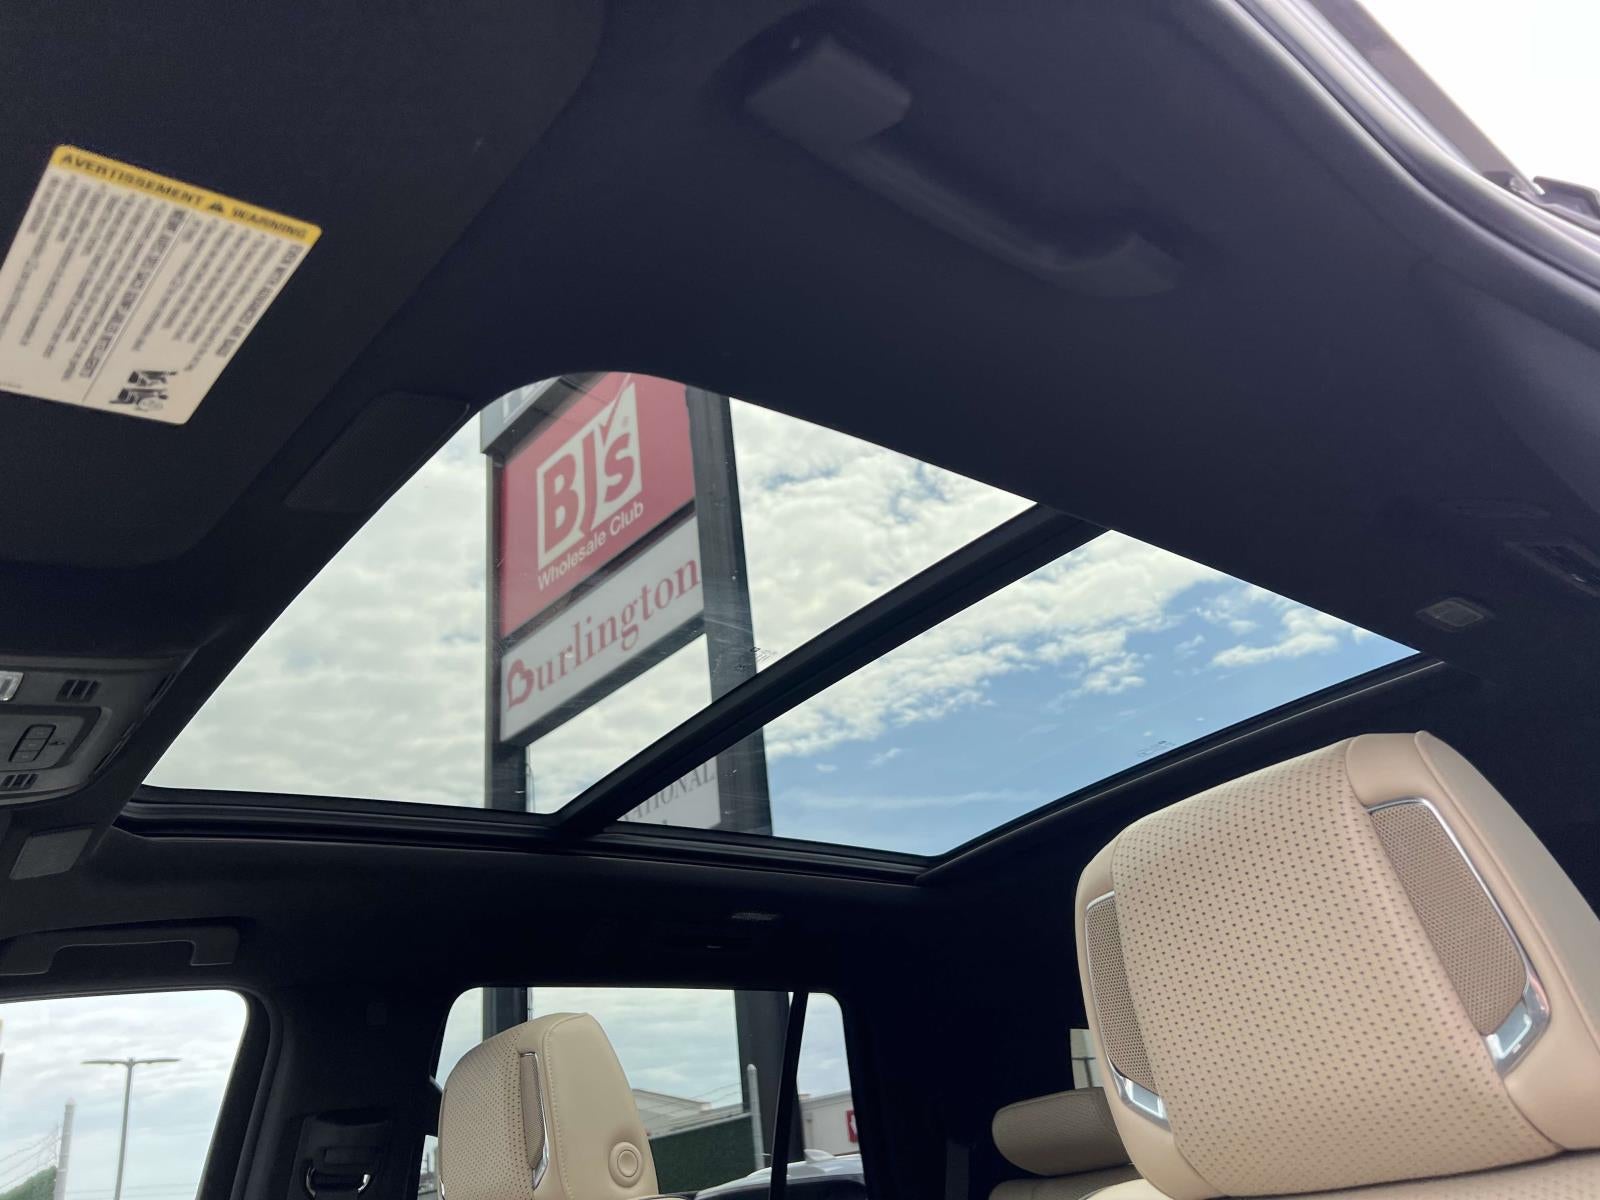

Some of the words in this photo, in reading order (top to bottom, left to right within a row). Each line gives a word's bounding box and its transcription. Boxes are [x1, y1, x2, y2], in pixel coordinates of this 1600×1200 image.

[537, 530, 606, 592] Wholesale
[609, 500, 645, 537] Club
[506, 559, 701, 708] Burlington
[624, 763, 715, 821] ATIONAL
